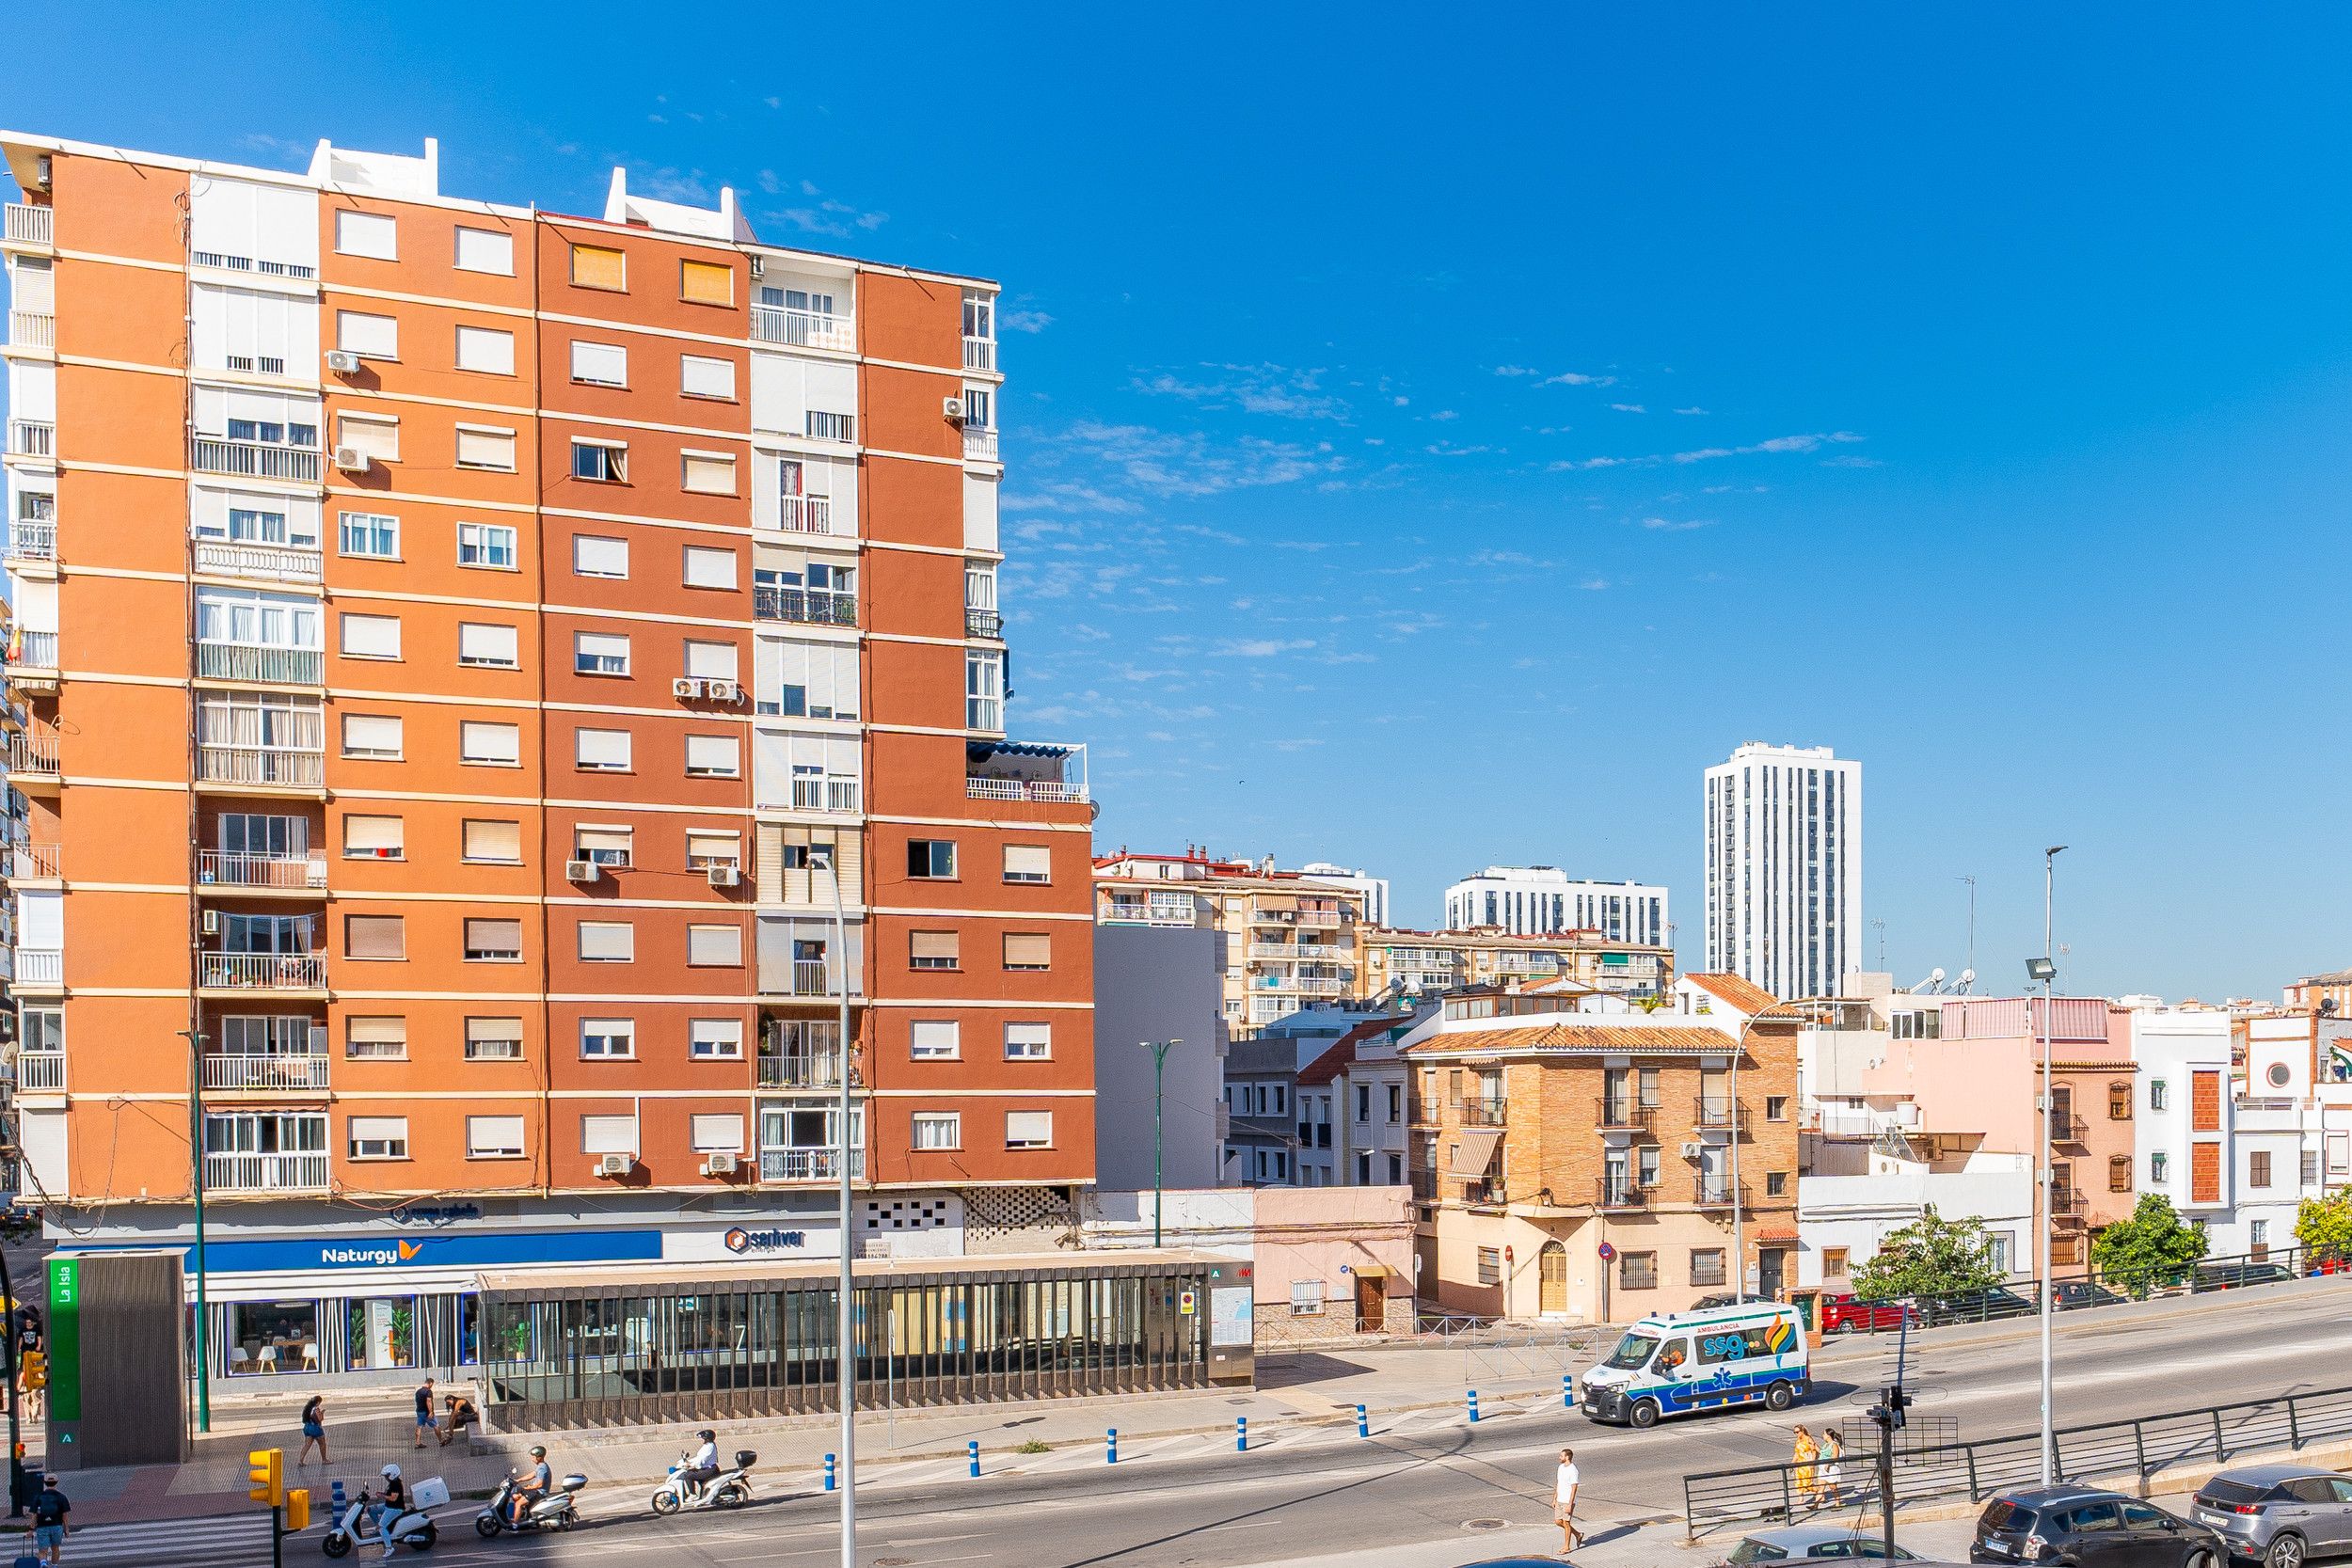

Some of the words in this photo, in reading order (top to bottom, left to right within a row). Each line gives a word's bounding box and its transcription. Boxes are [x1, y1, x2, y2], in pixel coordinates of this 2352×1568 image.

[322, 1248, 397, 1264] Naturgy
[58, 1266, 71, 1286] Isla
[58, 1289, 71, 1303] La
[1697, 1323, 1740, 1333] AMBULANCIA
[1704, 1334, 1744, 1361] ssg
